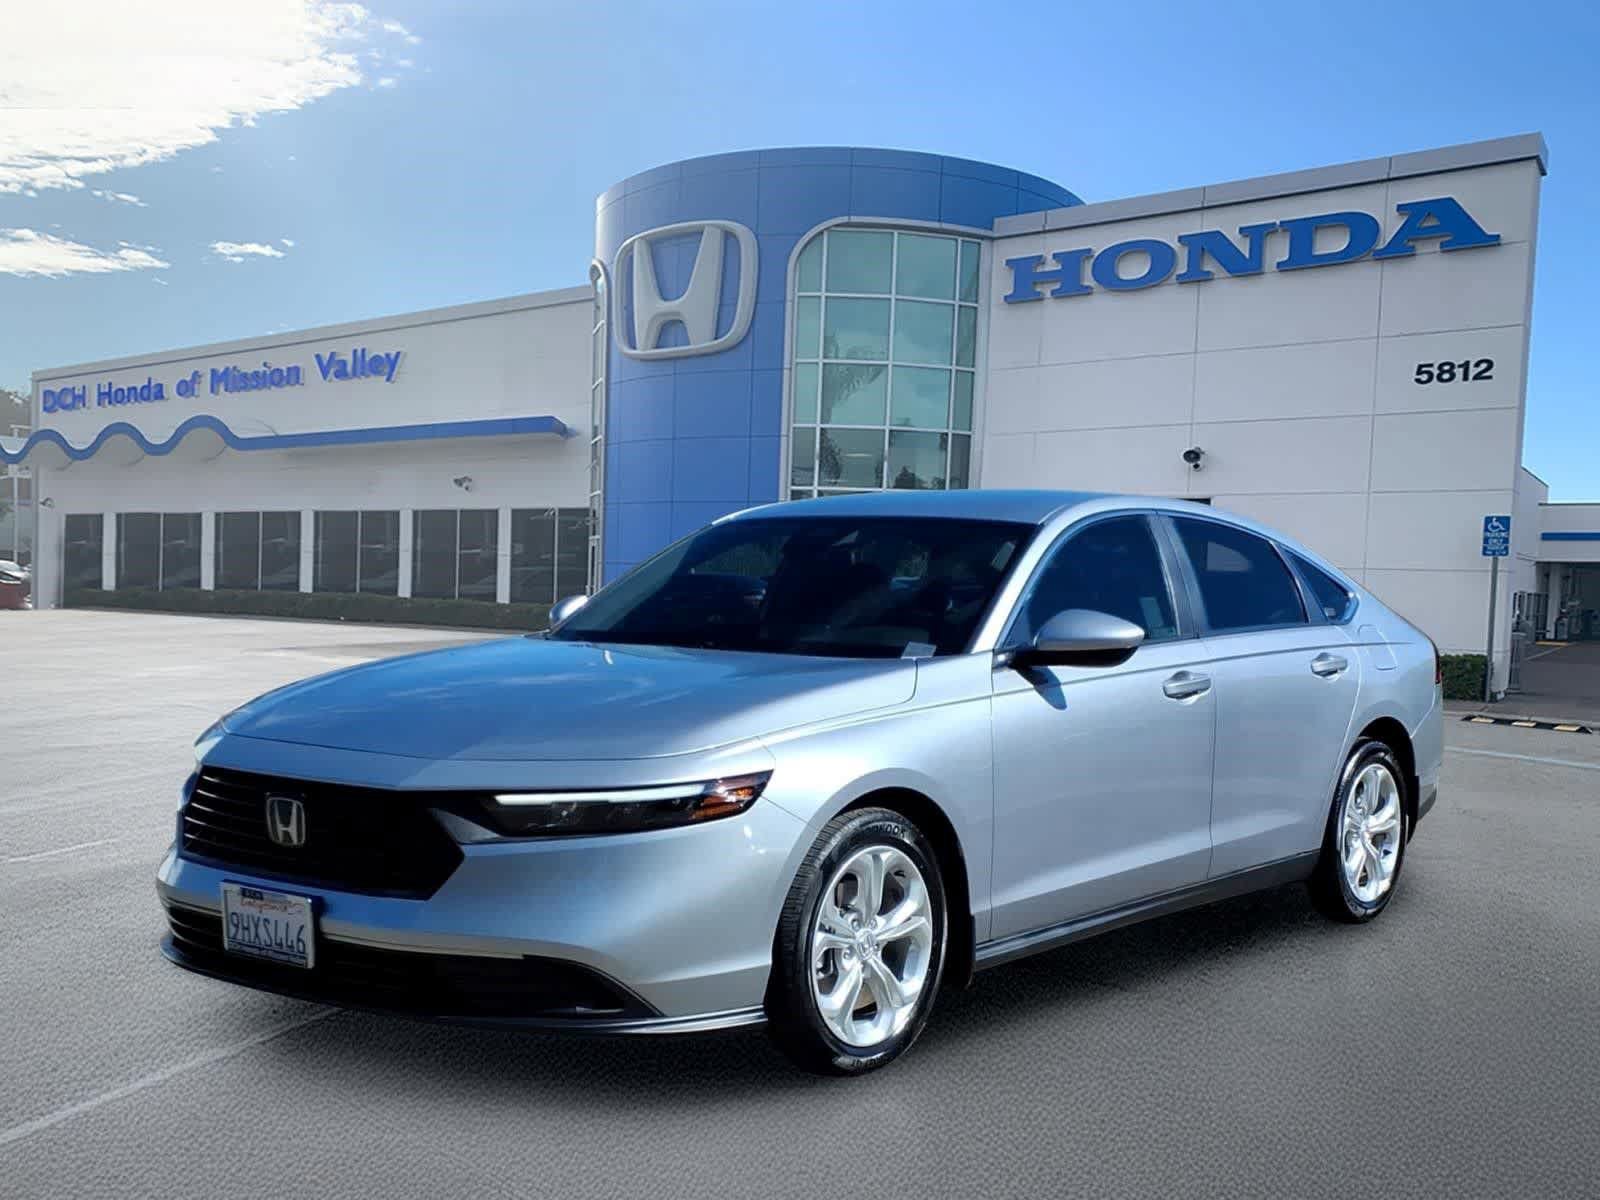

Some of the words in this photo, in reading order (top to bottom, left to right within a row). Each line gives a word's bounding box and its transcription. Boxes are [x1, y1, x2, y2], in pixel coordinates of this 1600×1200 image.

[1002, 196, 1502, 305] HONDA
[42, 384, 87, 413] DCH
[97, 377, 165, 407] Honda
[175, 373, 201, 399] of
[209, 361, 302, 396] Mission
[314, 348, 402, 384] Valley
[1413, 358, 1495, 385] 5812
[230, 912, 306, 955] 9HXS446
